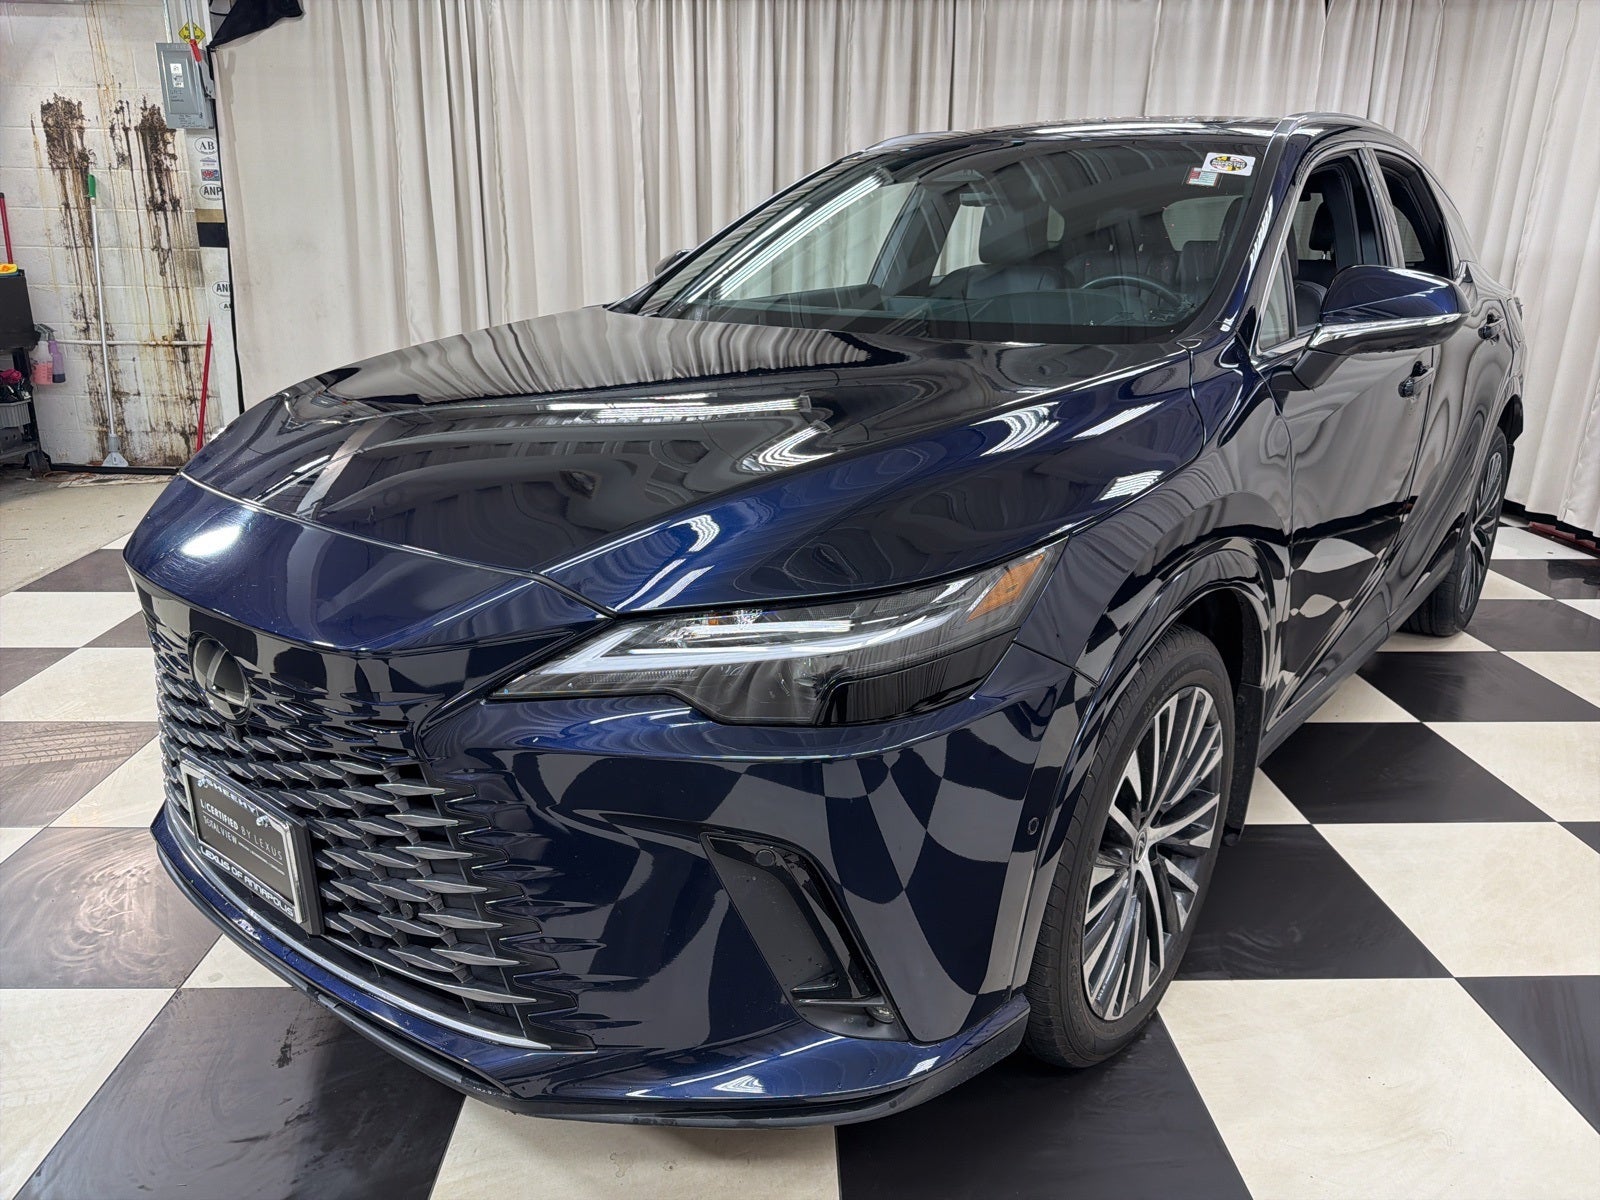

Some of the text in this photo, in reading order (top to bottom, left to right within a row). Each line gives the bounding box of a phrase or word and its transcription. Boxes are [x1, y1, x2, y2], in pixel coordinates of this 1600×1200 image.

[200, 141, 215, 150] AB
[216, 283, 231, 292] AN
[241, 826, 251, 841] BY
[254, 835, 284, 861] LEXUS
[199, 845, 295, 917] LEXUS OF ANNAPOLIS
